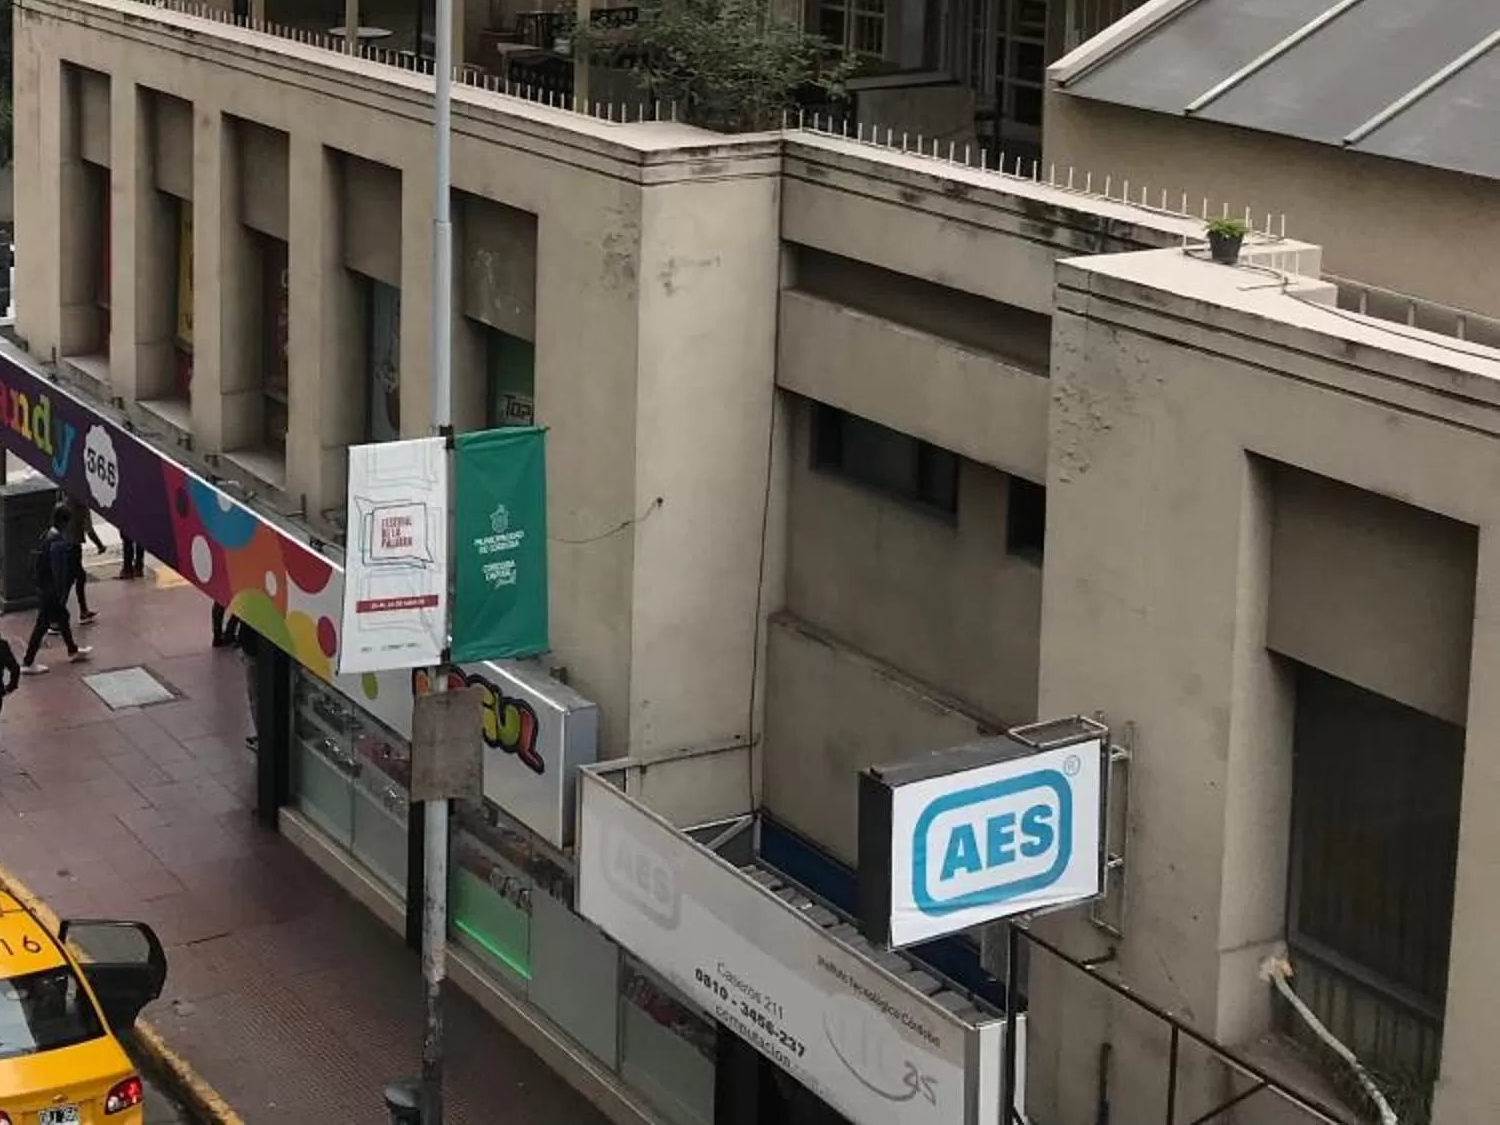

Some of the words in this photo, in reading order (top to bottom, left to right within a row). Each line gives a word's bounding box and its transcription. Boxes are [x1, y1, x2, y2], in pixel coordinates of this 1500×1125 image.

[86, 449, 116, 488] 365
[939, 804, 1054, 883] AES
[695, 967, 728, 1001] 0810
[764, 996, 784, 1020] 211
